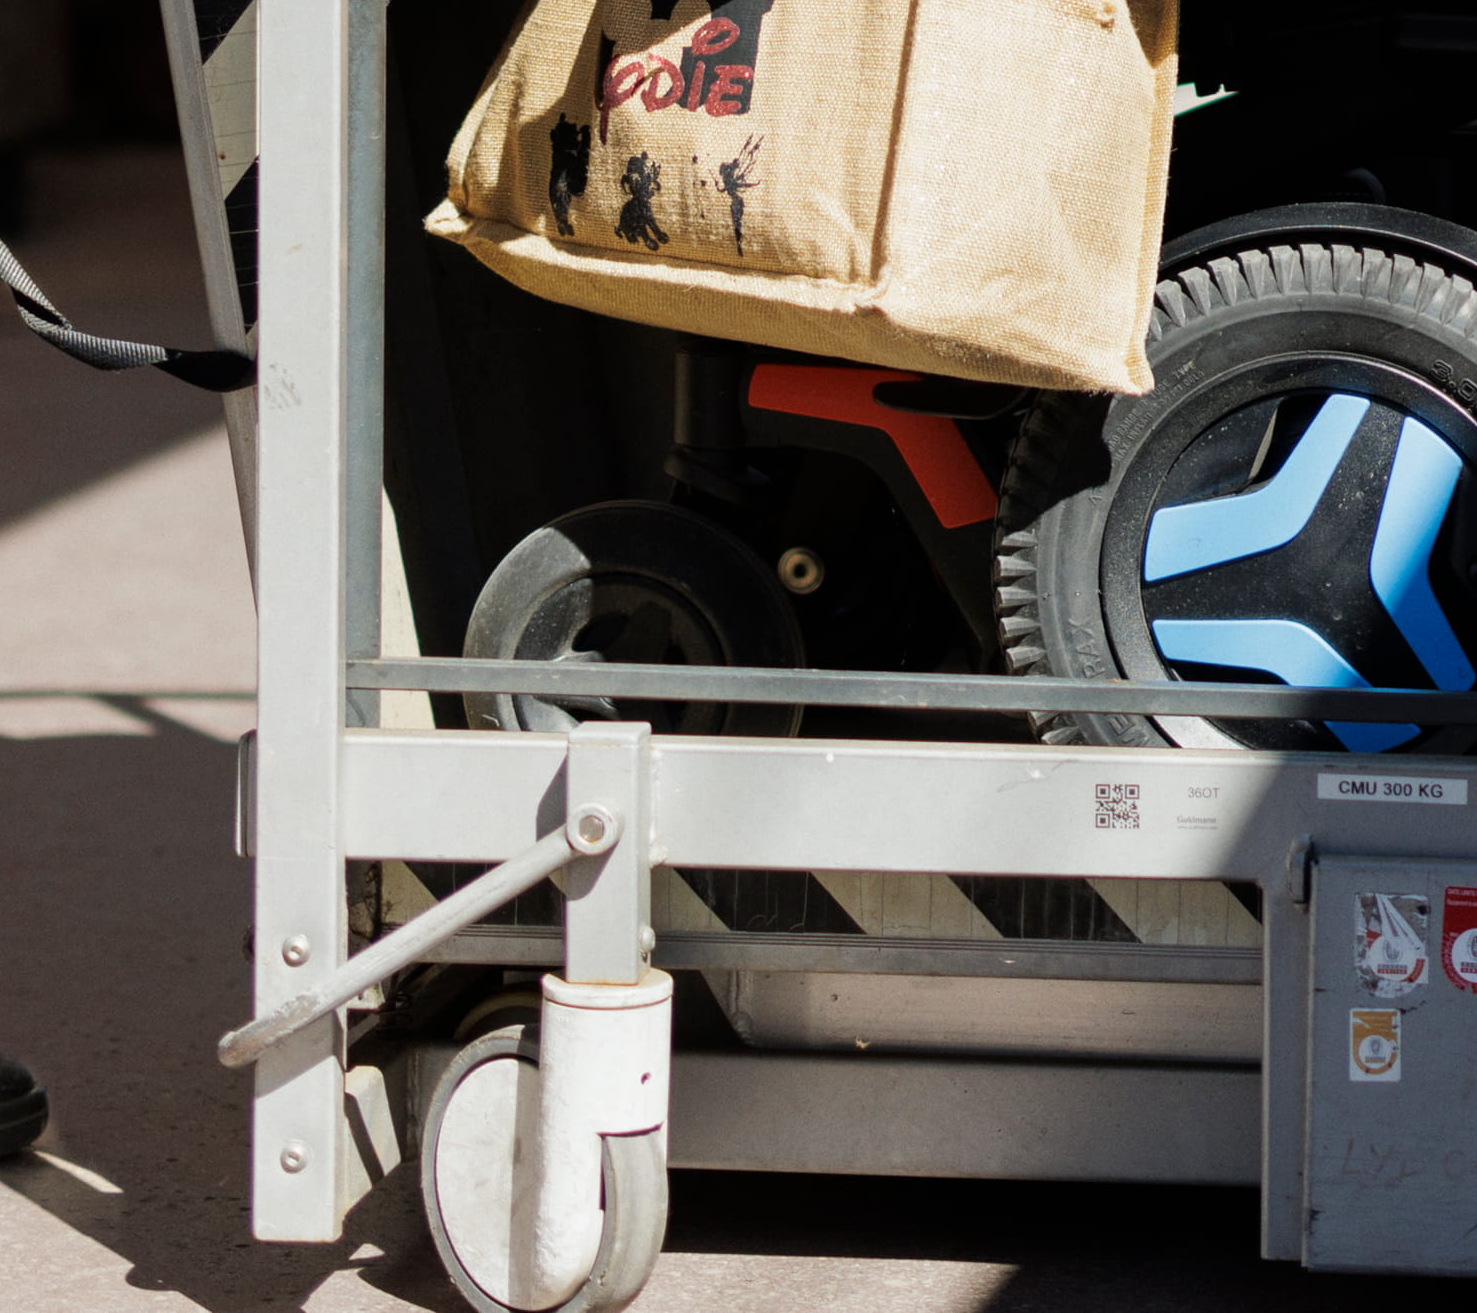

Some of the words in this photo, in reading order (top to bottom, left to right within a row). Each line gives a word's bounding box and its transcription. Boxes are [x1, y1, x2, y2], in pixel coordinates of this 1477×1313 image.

[1338, 780, 1378, 796] CMU
[1383, 782, 1412, 797] 300
[1417, 784, 1443, 798] KG
